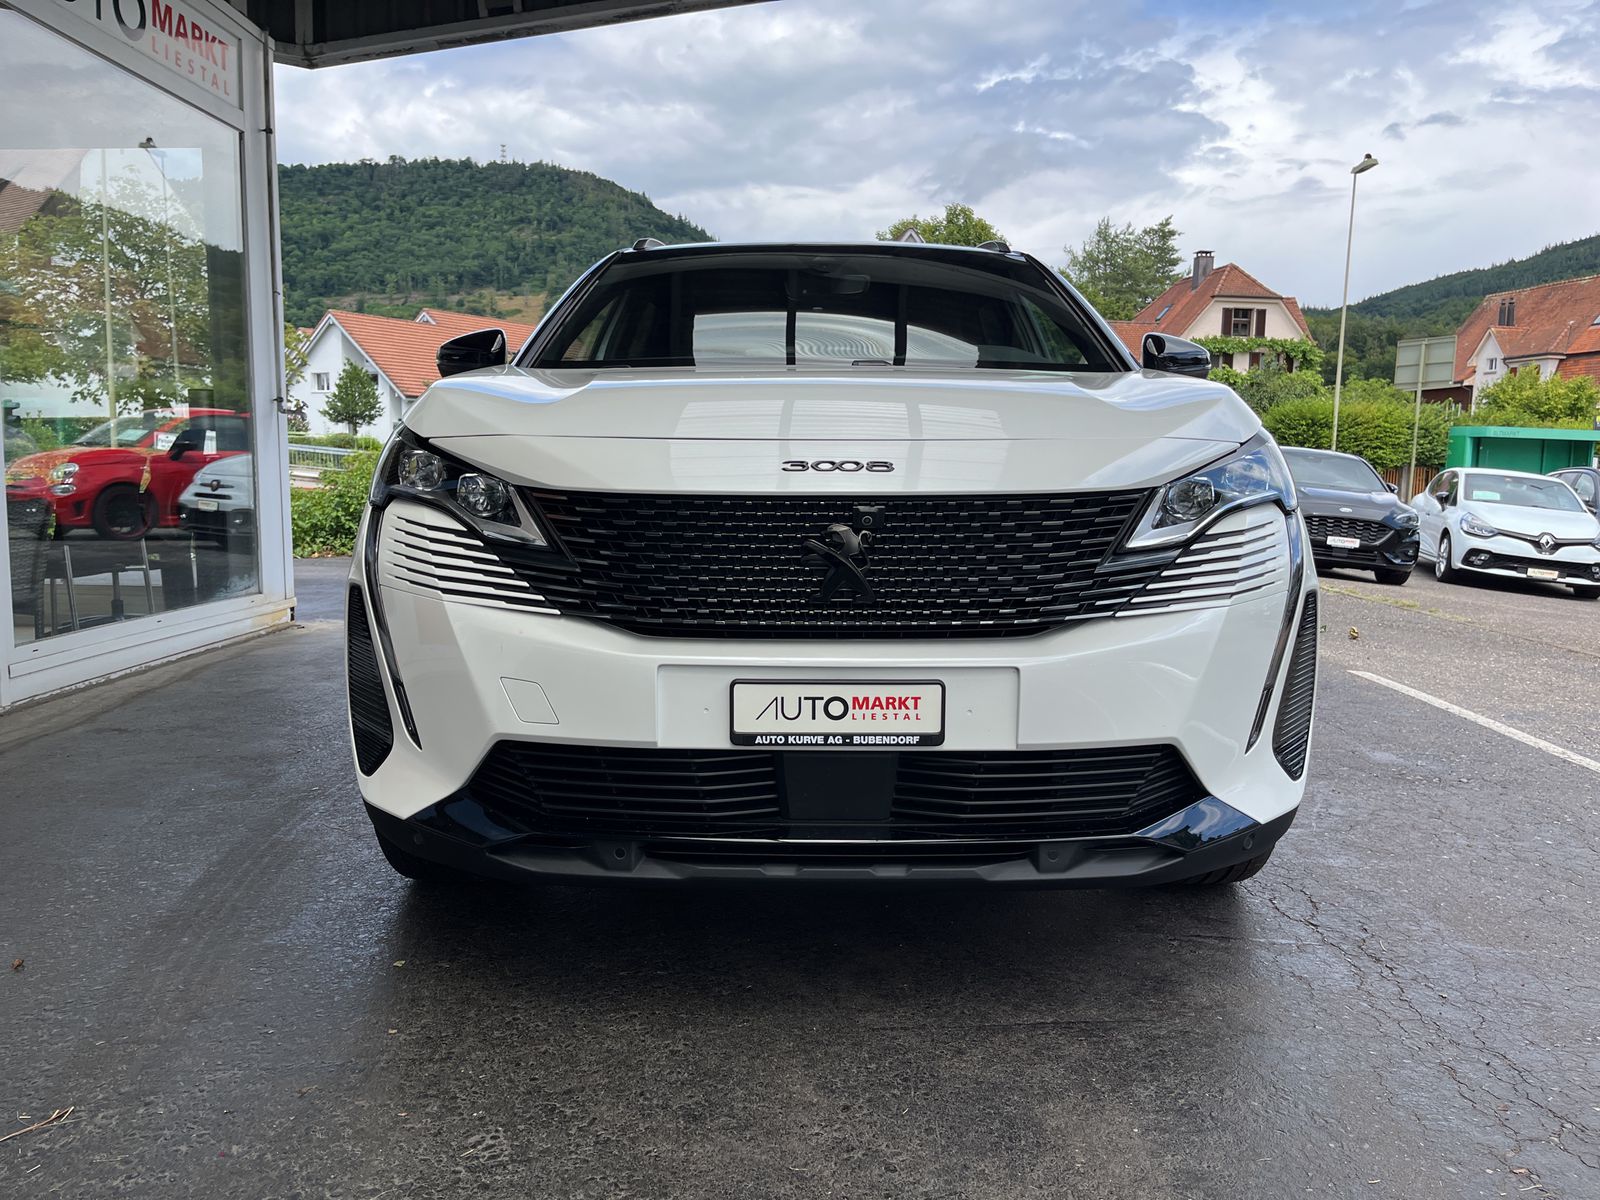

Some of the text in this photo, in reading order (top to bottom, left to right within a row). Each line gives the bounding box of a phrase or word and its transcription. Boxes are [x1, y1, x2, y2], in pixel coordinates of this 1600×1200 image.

[151, 0, 229, 71] MARKT
[152, 36, 229, 96] LIESTAL
[781, 460, 895, 472] 3008
[755, 696, 921, 721] AUTO MARKT
[755, 735, 785, 744] AUTO
[788, 735, 824, 744] KURVE
[827, 735, 842, 744] AG
[853, 735, 920, 744] BUBENDORF
